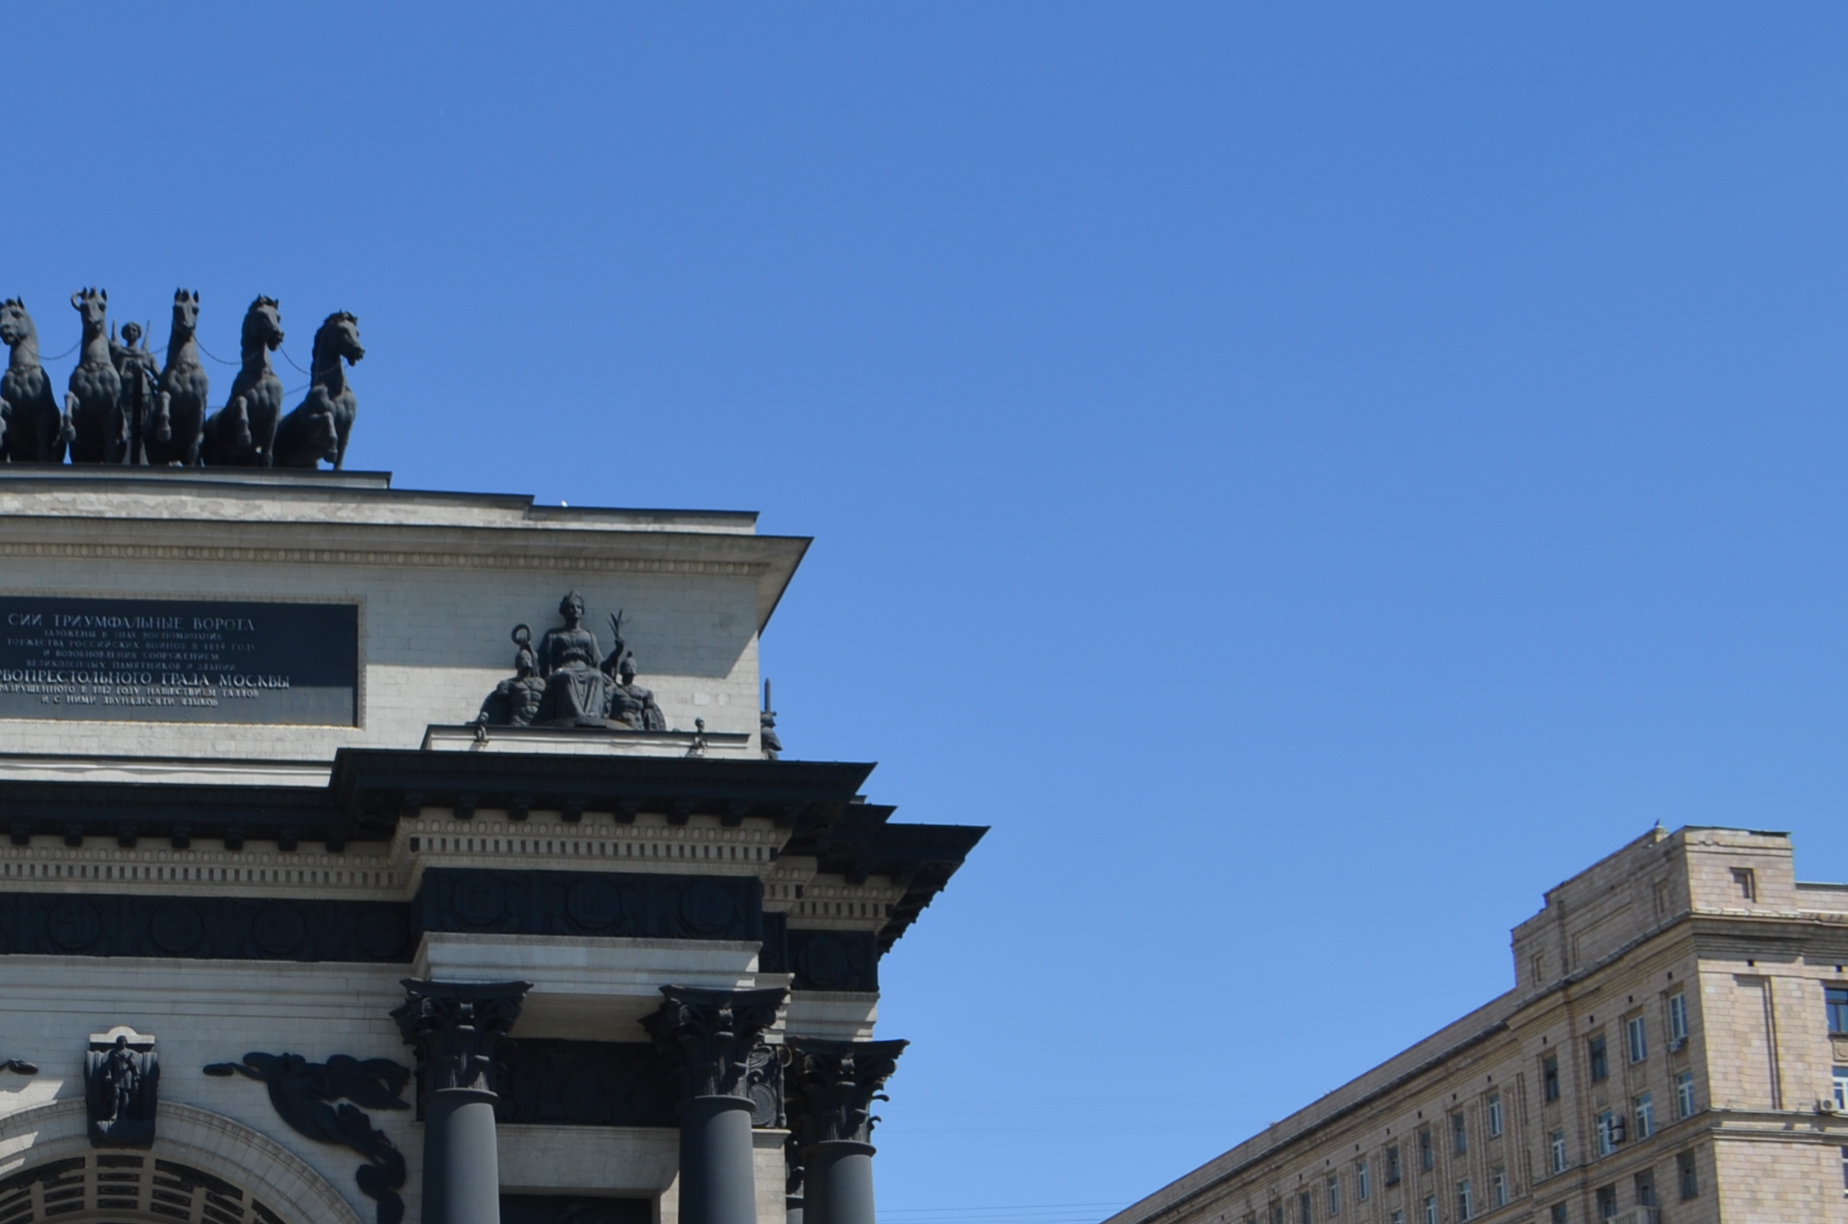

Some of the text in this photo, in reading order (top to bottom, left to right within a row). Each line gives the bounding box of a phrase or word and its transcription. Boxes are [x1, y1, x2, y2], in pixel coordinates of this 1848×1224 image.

[8, 614, 254, 631] СИИ ТРИУМФАЛЬНЫЕ ВОРОТА
[162, 673, 209, 686] ГРАДА
[219, 674, 290, 688] МОСКВЫ
